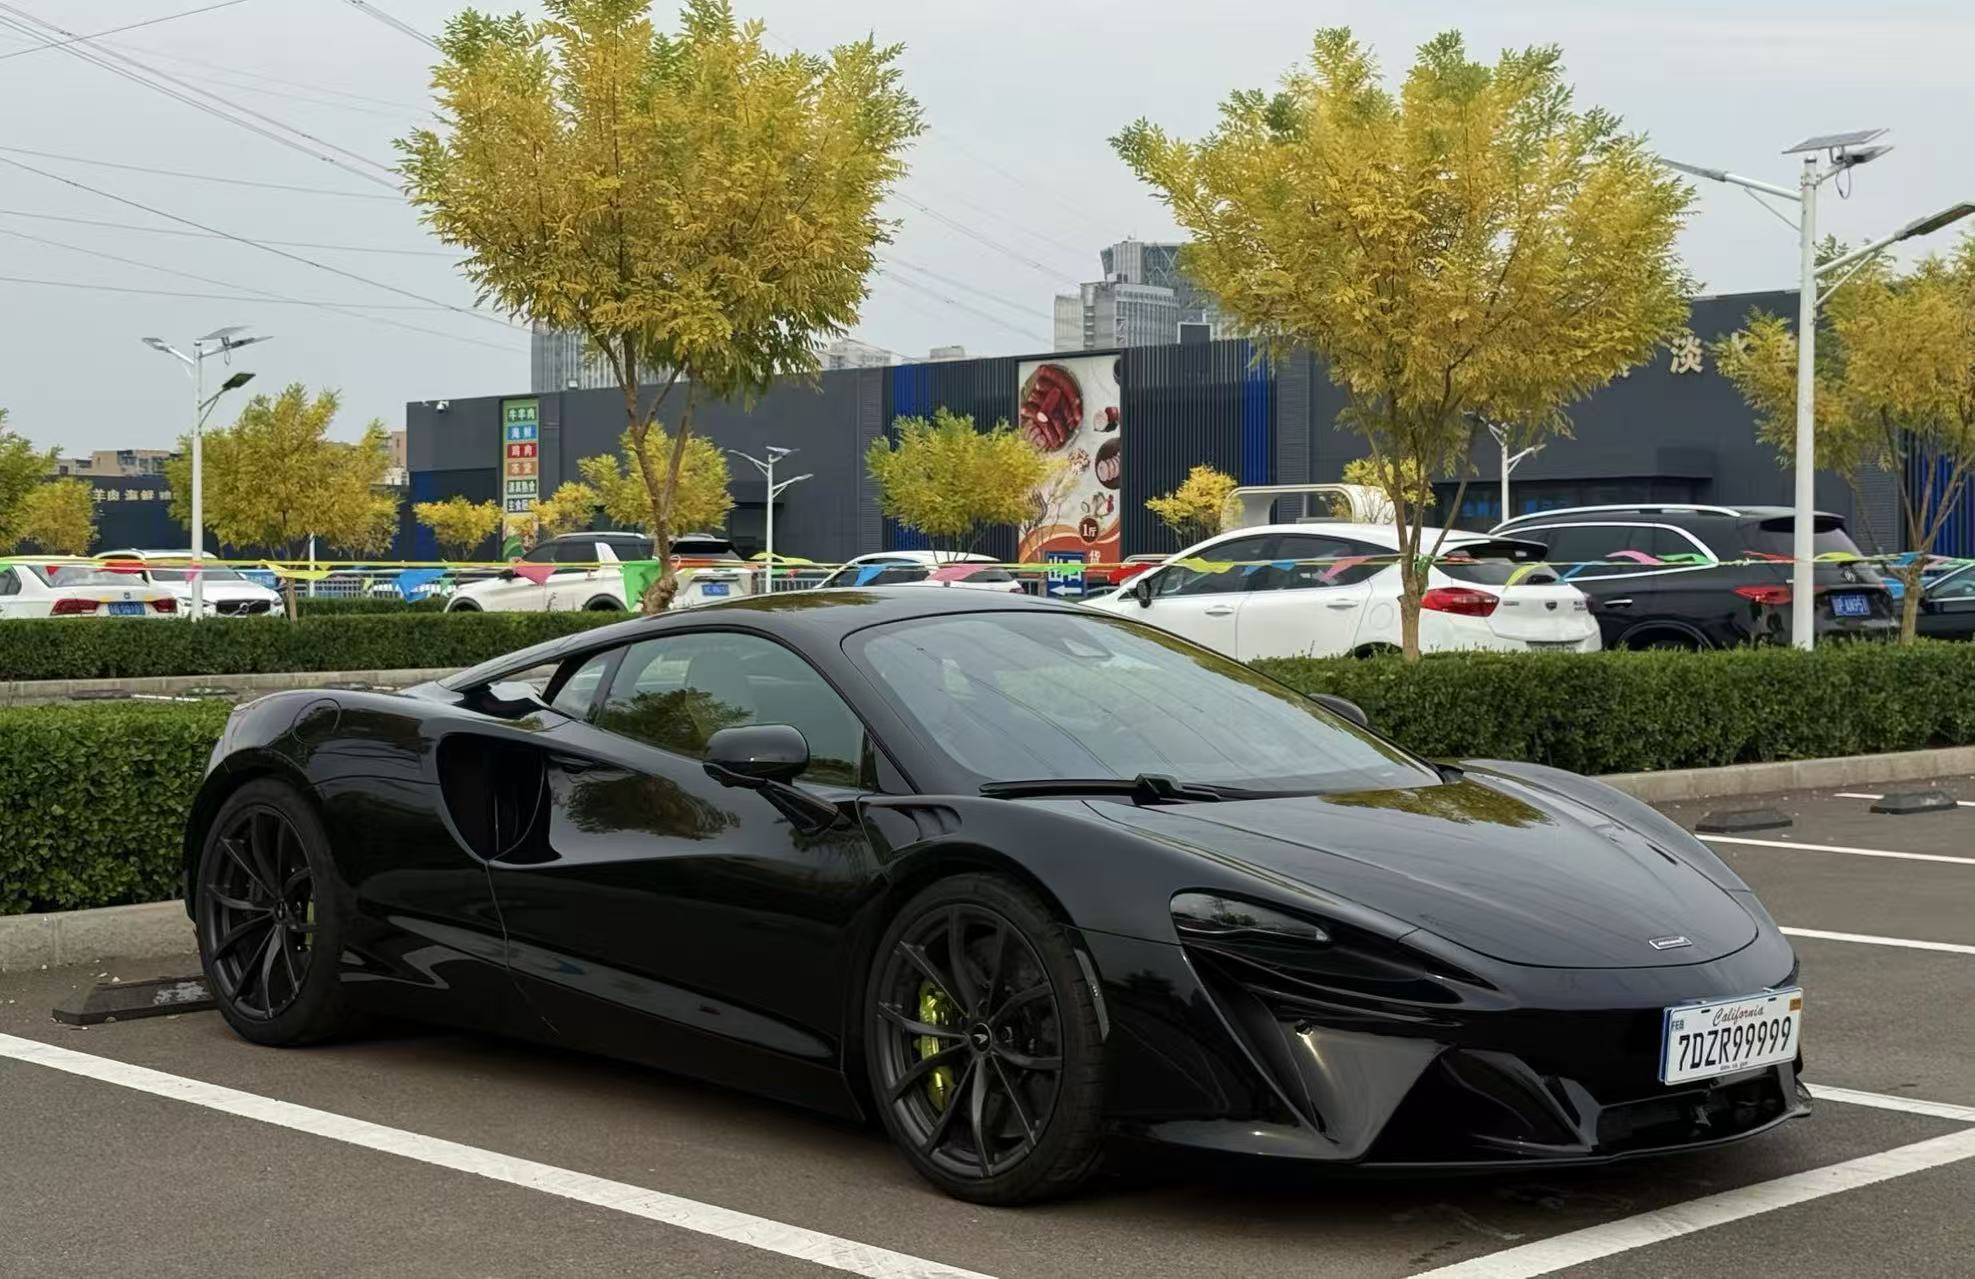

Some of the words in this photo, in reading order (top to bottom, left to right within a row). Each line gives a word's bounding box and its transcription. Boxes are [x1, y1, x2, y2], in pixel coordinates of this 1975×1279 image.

[1669, 335, 1704, 374] 淡
[92, 488, 120, 503] 羊肉
[1712, 1005, 1764, 1028] California
[1678, 1016, 1792, 1071] 7DZR99999
